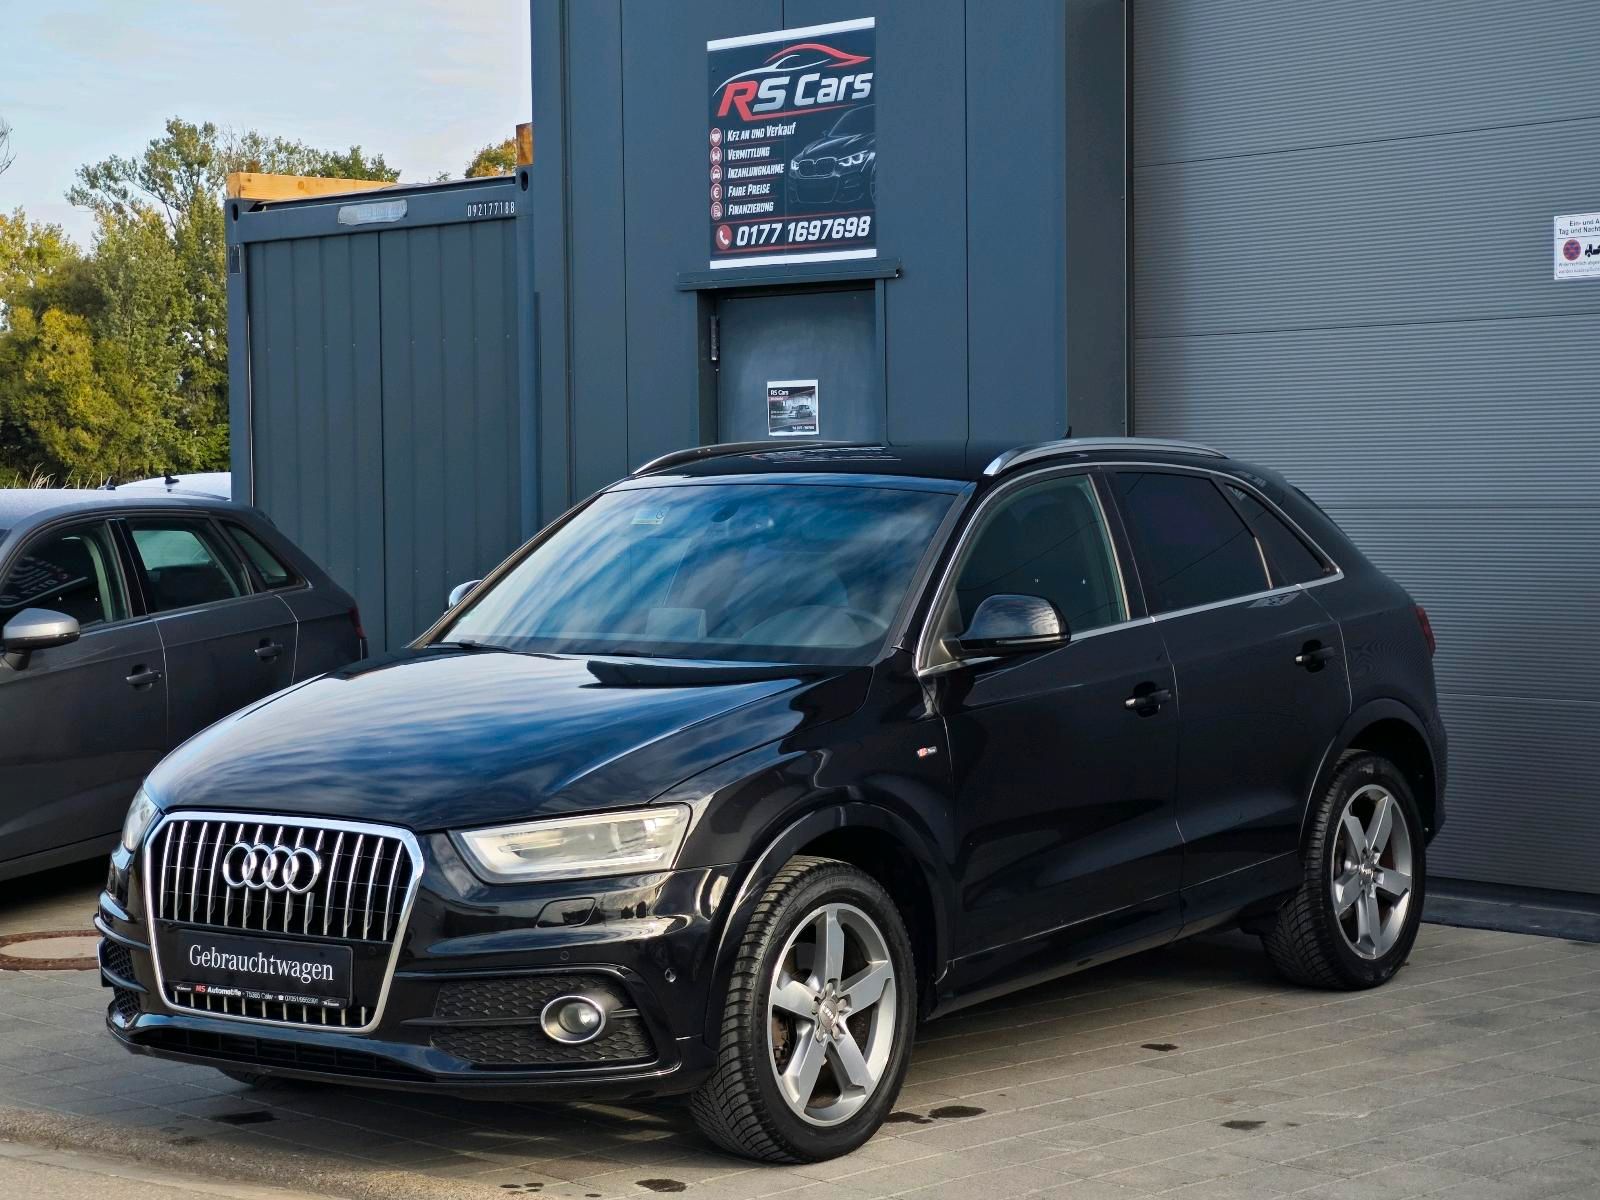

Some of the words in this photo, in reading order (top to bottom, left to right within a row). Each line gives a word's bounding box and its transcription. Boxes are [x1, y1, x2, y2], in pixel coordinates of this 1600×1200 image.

[718, 76, 791, 121] RS
[794, 72, 874, 107] Cars
[728, 186, 746, 197] FAIRE
[747, 183, 771, 196] PREISE
[736, 223, 783, 246] 0177
[787, 215, 871, 243] 1697698
[189, 944, 334, 984] Gebrauchtwagen
[207, 986, 242, 997] Automobile
